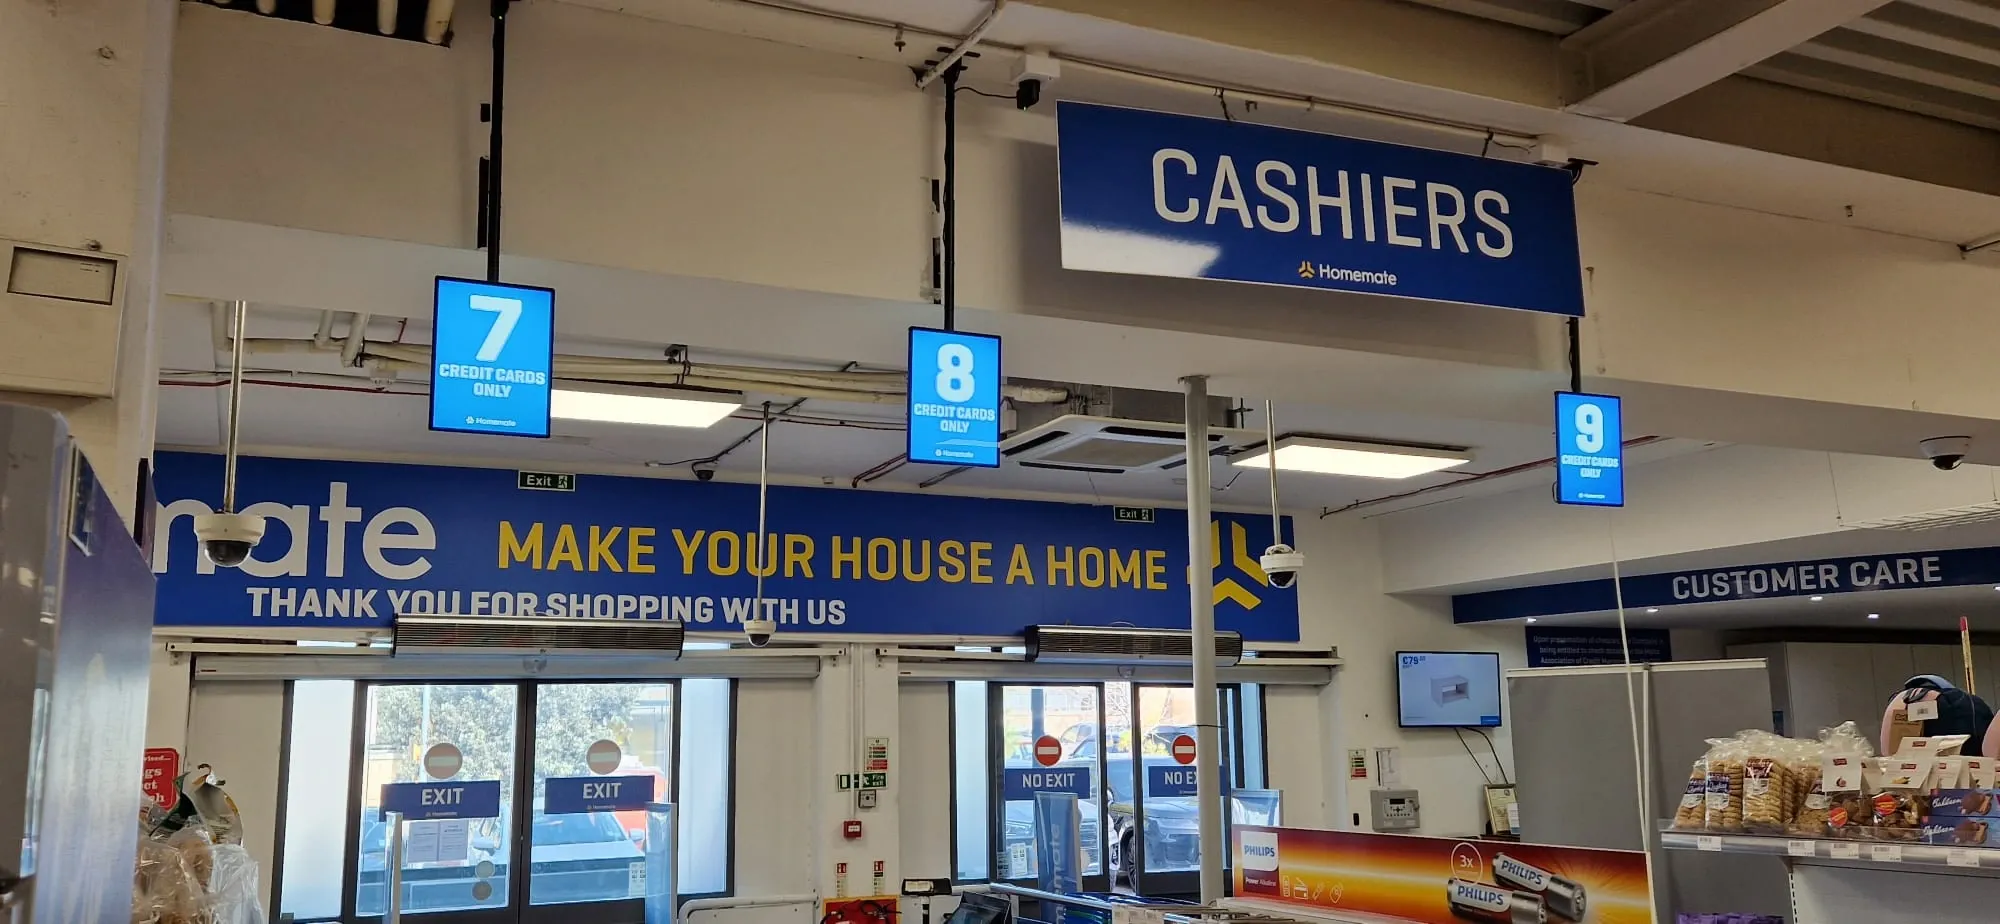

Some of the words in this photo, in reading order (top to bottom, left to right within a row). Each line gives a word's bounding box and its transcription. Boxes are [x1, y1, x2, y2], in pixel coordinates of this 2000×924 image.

[1152, 148, 1513, 258] CASHIERS
[1319, 264, 1397, 286] Homemate
[470, 294, 523, 363] 7
[439, 363, 494, 380] CREDIT
[495, 368, 546, 385] CARDS
[936, 343, 976, 403] 8
[473, 382, 512, 398] ONLY
[914, 403, 956, 418] CREDIT
[956, 406, 995, 421] CARDS
[940, 419, 970, 433] ONLY
[1575, 403, 1604, 453] 9
[526, 474, 553, 487] Exit
[1119, 508, 1137, 519] Exit
[498, 521, 657, 574] MAKE
[671, 528, 816, 579] YOUR
[831, 535, 993, 585] HOUSE
[1005, 543, 1035, 585] A
[1046, 545, 1168, 590] HOME
[1672, 562, 1841, 600] CUSTOMER
[1850, 556, 1943, 587] CARE
[246, 587, 379, 618] THANK
[387, 589, 461, 616] YOU
[470, 591, 540, 617] FOR
[546, 593, 714, 624] SHOPPING
[720, 596, 800, 625] WITH
[807, 599, 846, 625] US
[1022, 774, 1042, 788] NO
[1046, 773, 1076, 788] EXIT
[1164, 771, 1183, 785] NO
[1186, 771, 1198, 784] EX
[421, 787, 465, 806] EXIT
[583, 782, 622, 799] EXIT
[1244, 844, 1276, 858] PHILIPS
[1459, 854, 1474, 868] 3x
[1501, 860, 1544, 885] PHILIPS
[1457, 885, 1504, 905] PHILIPS
